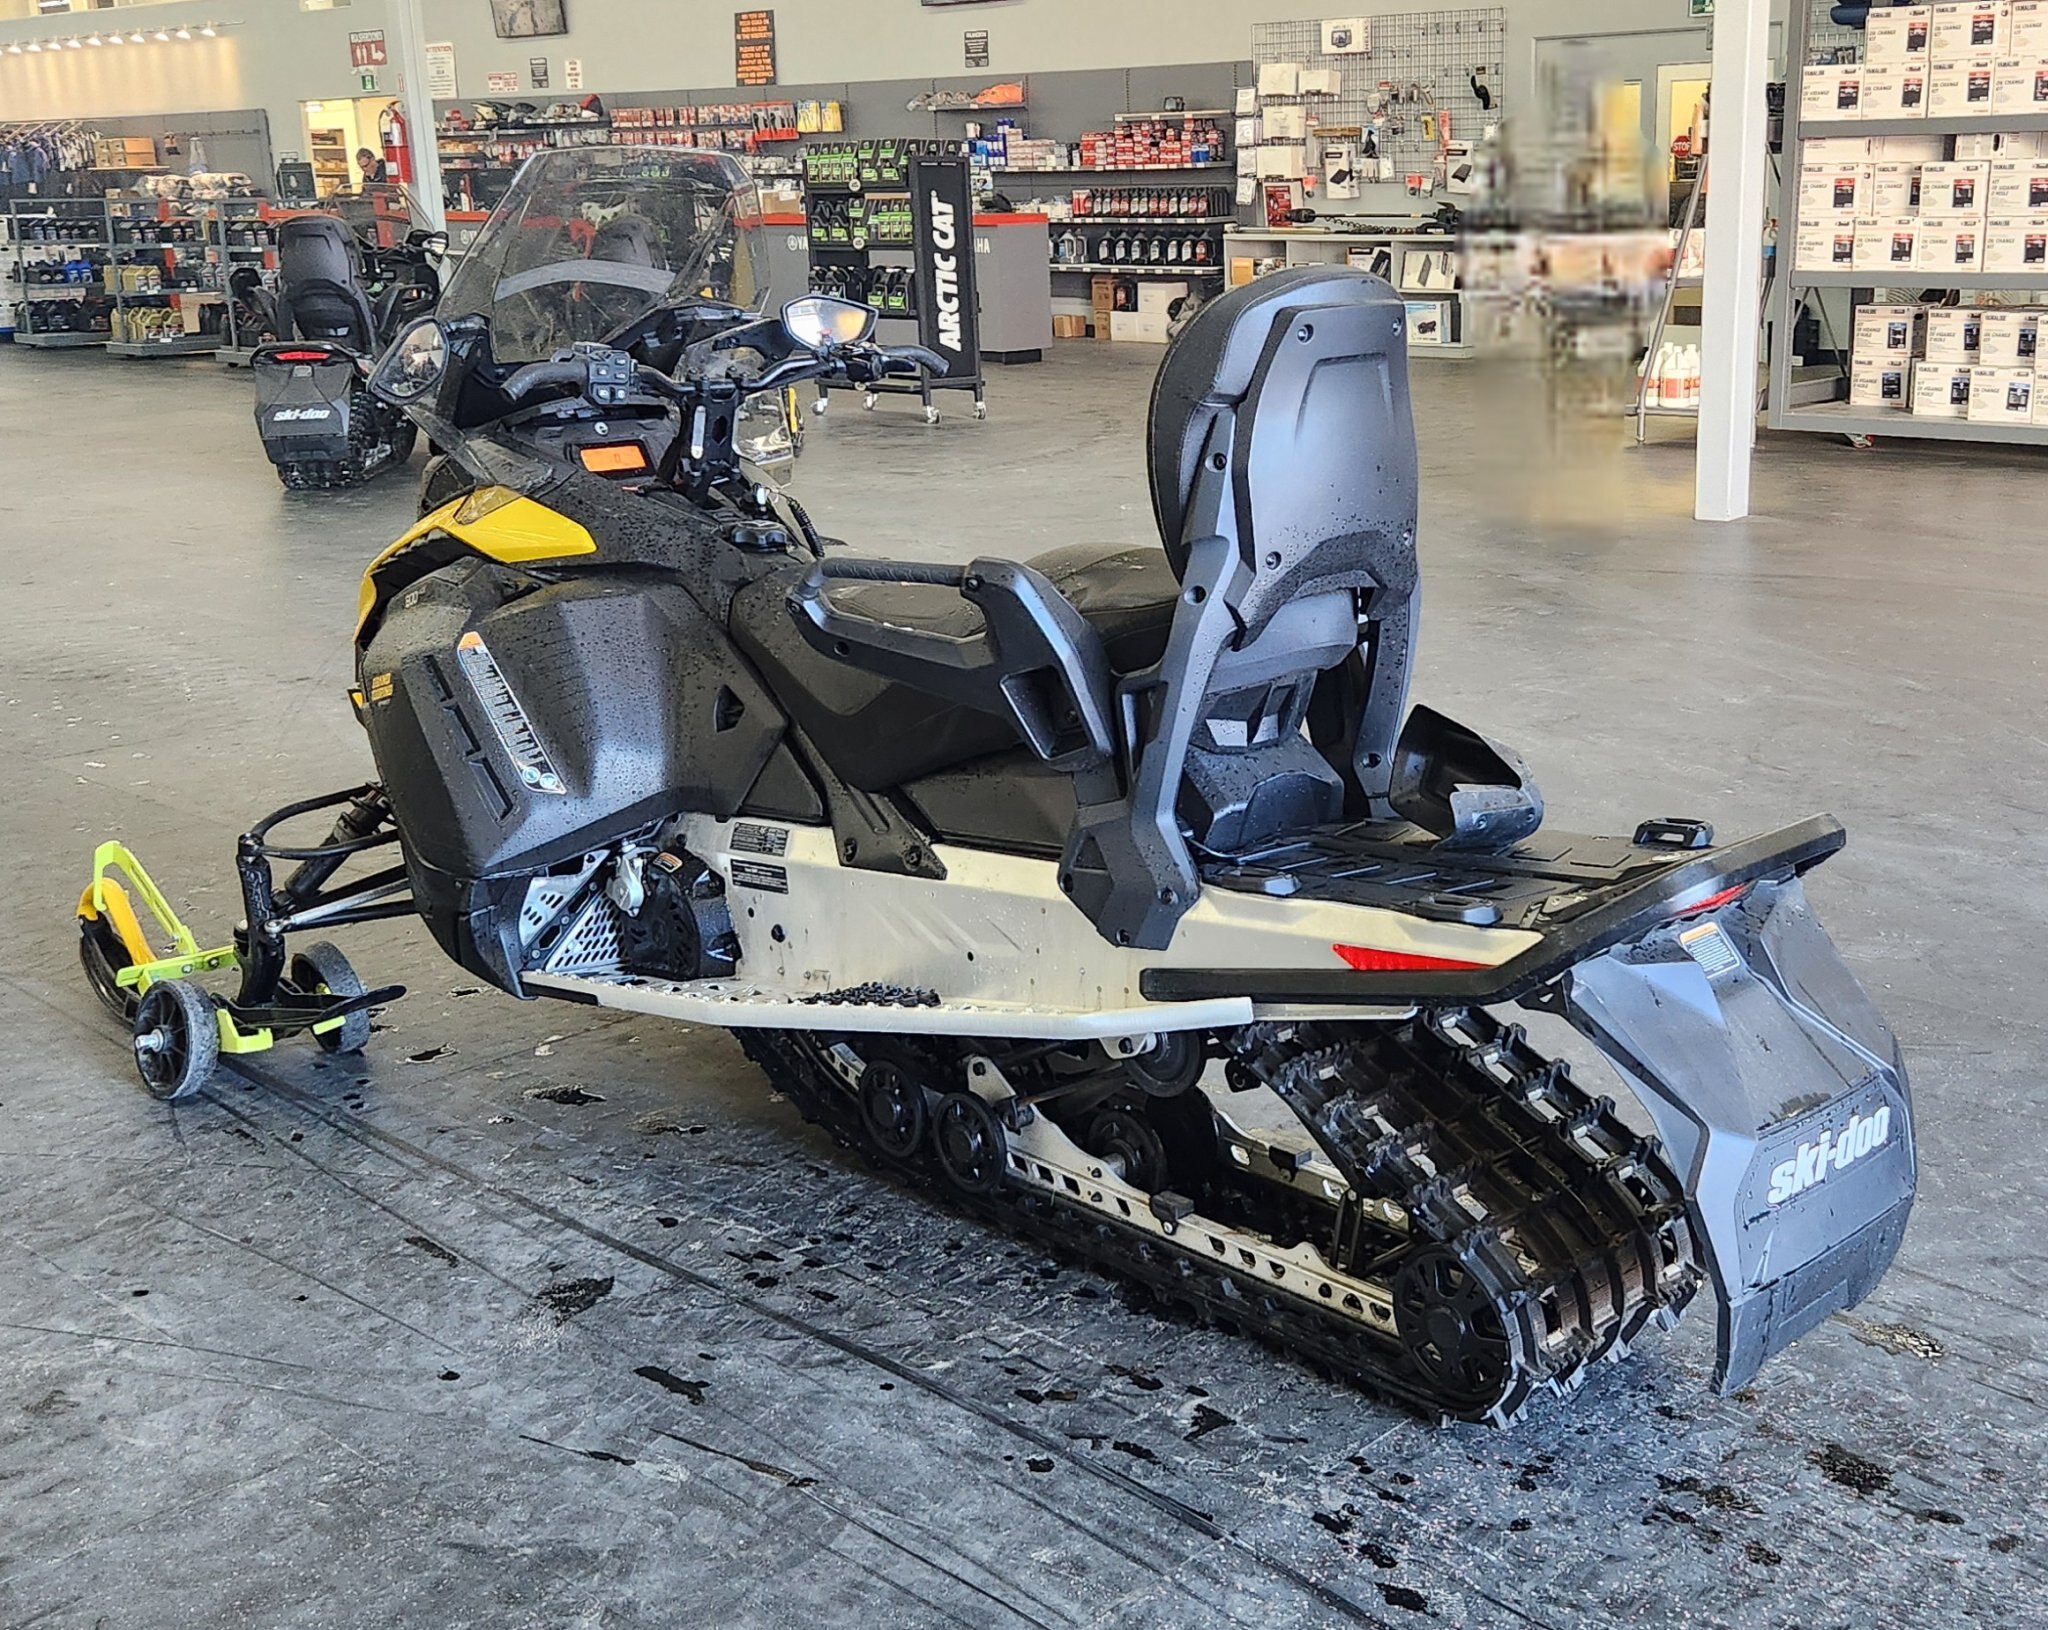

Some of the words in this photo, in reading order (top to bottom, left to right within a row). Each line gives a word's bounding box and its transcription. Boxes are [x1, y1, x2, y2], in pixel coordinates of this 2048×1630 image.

[931, 199, 956, 250] CAT
[934, 253, 961, 351] ARCTIC
[273, 408, 330, 421] ski-doo
[1767, 1106, 1890, 1204] ski-doo
